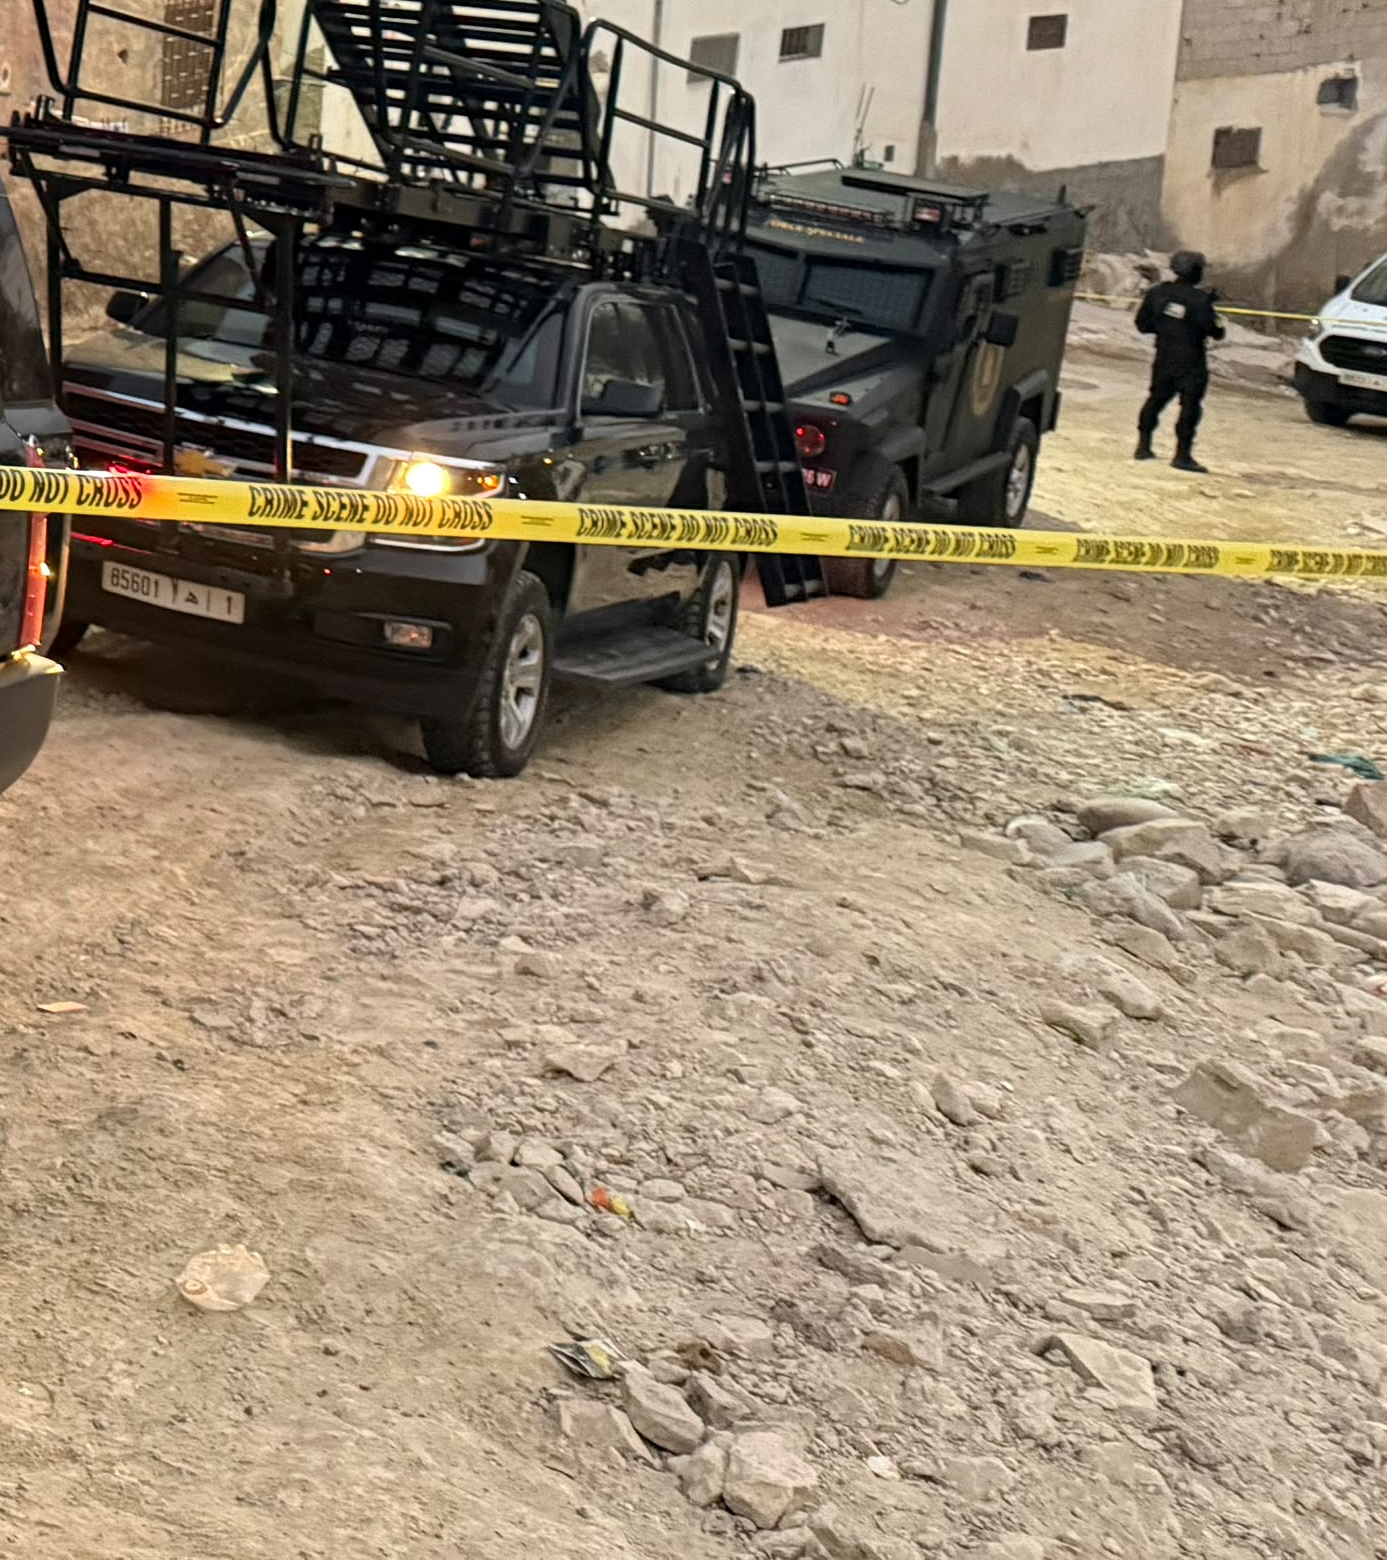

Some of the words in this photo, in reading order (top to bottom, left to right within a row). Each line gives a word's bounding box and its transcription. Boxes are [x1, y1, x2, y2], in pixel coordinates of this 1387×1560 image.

[28, 470, 74, 506] NOT
[76, 473, 143, 509] CROSS
[248, 485, 309, 519] CRIME
[311, 490, 369, 523] SCENE
[372, 495, 398, 524] DO
[399, 496, 434, 528] NOT
[437, 499, 493, 530] CROSS
[110, 567, 159, 598] 85601
